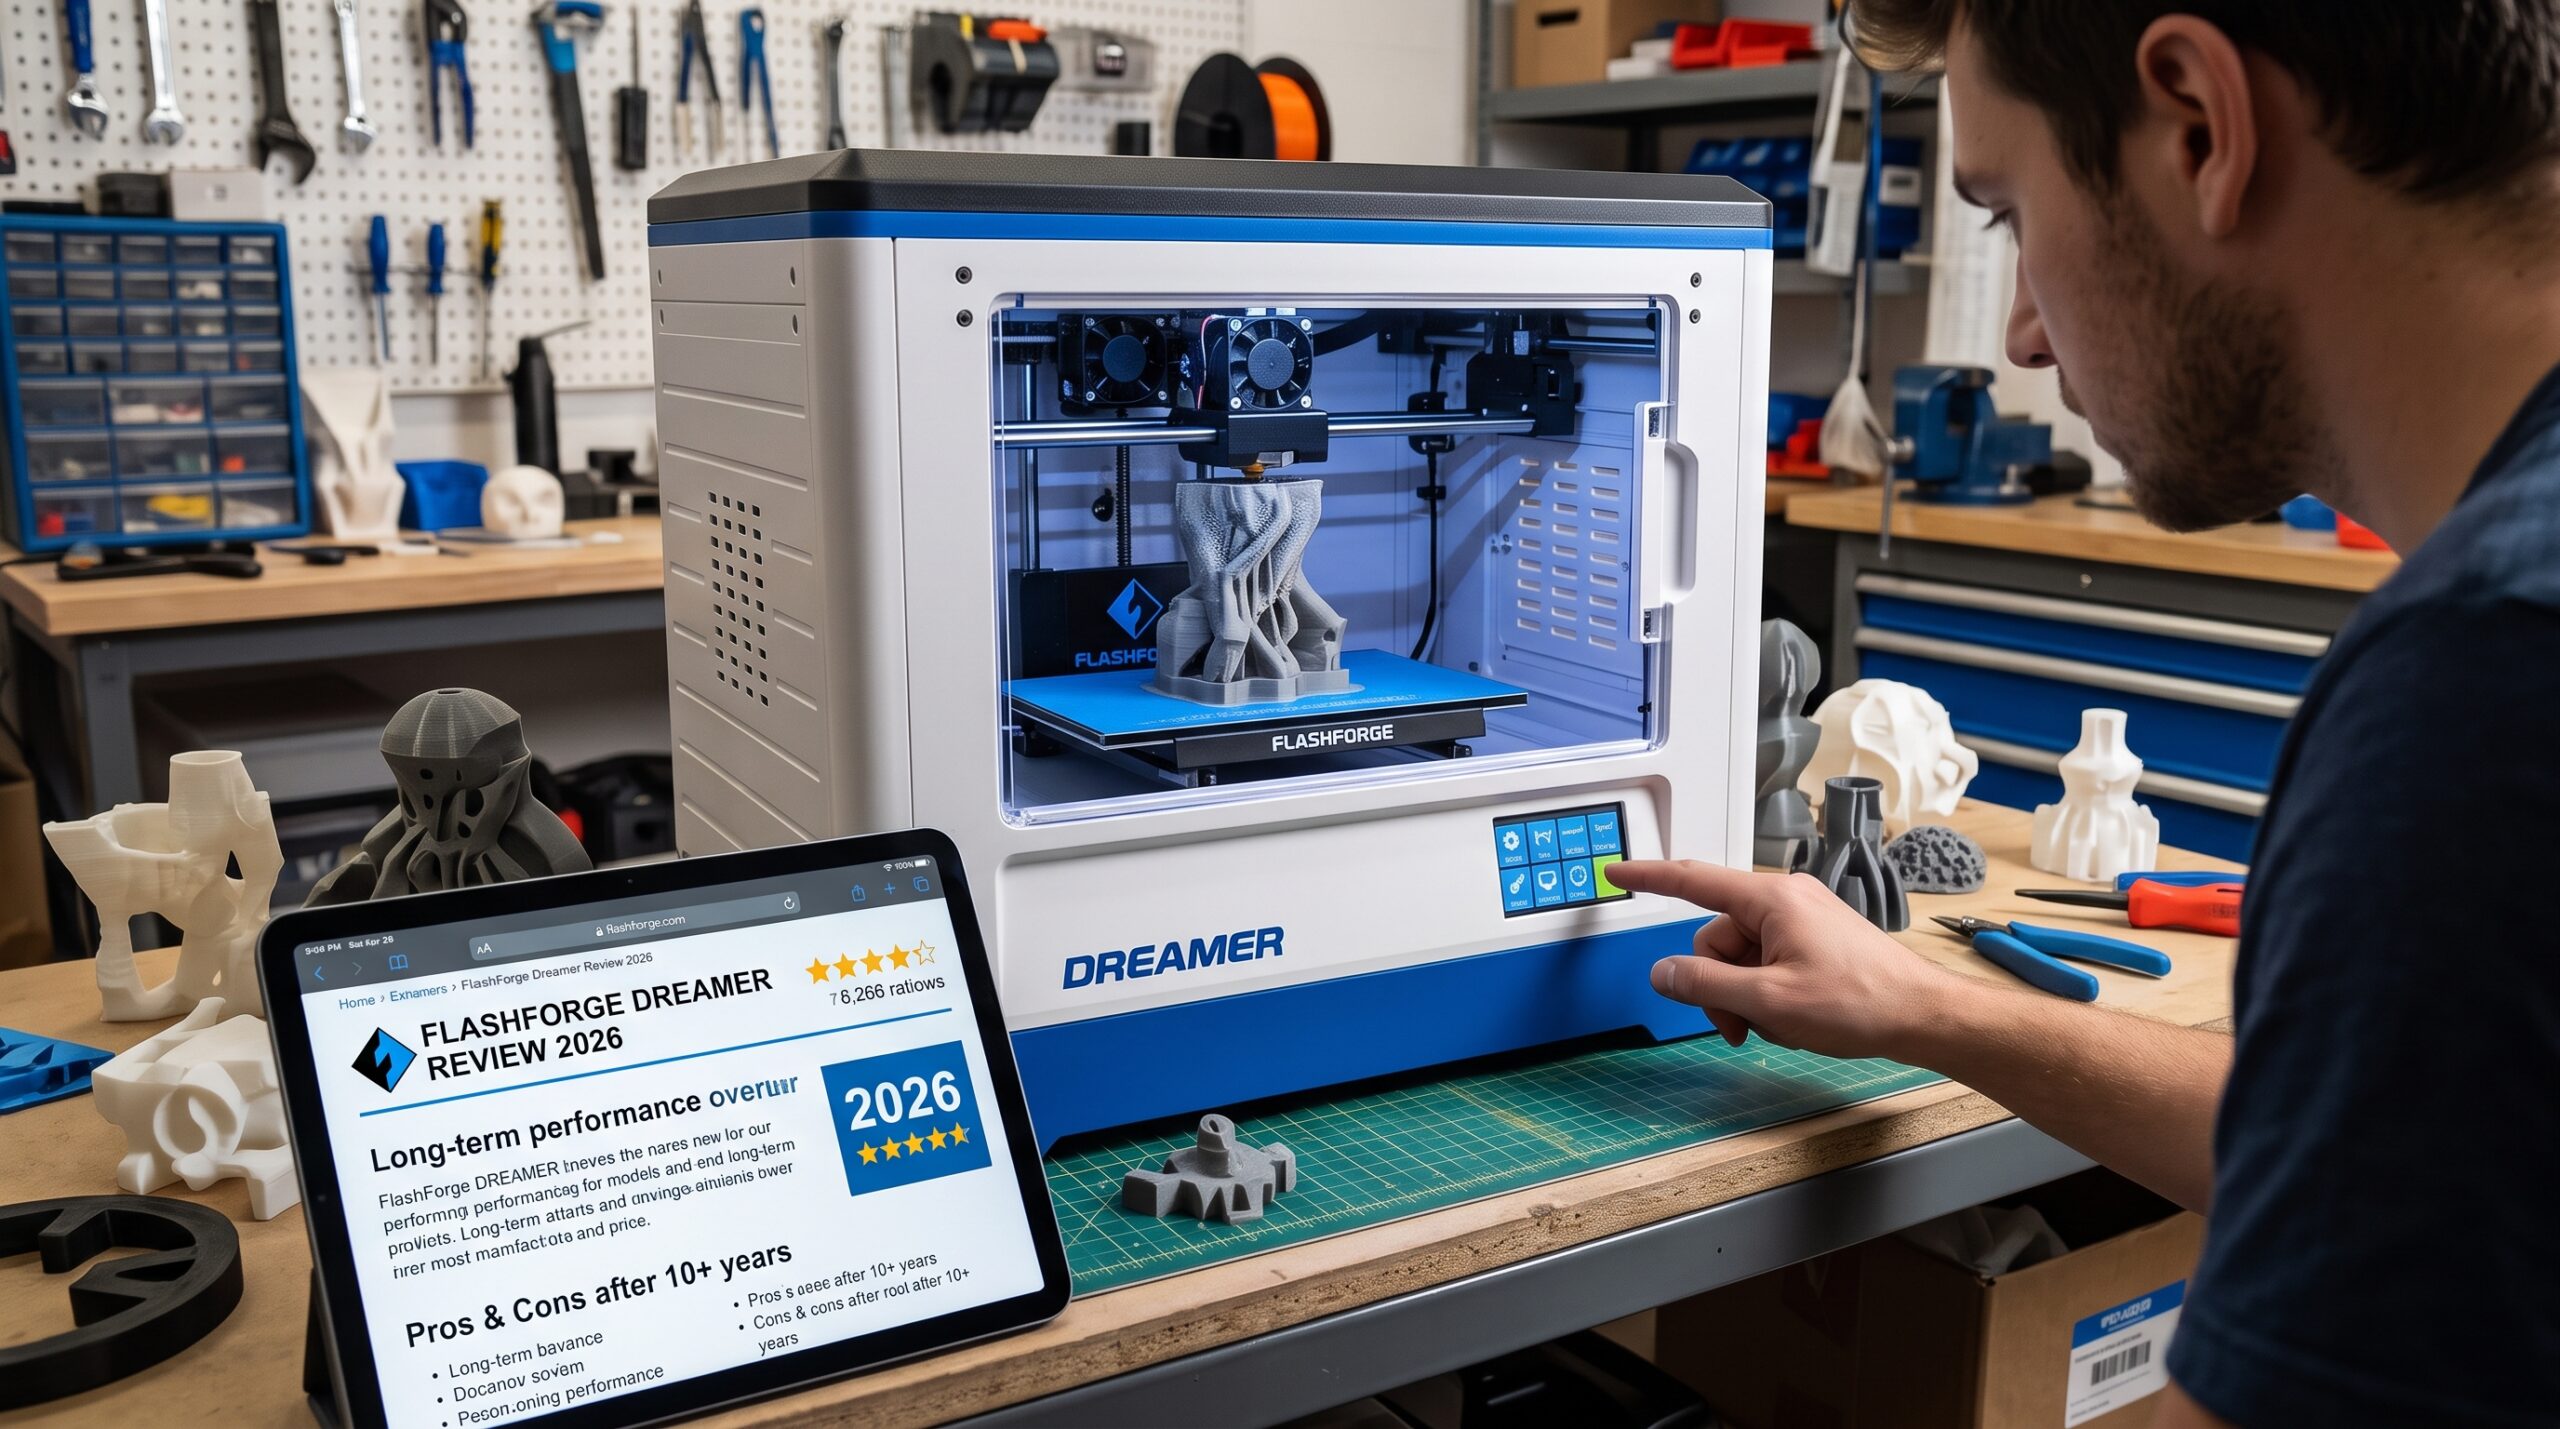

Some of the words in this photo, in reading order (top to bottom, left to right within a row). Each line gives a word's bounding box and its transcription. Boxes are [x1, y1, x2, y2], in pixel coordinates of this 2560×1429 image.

[1271, 723, 1394, 753] FLASHFORGE
[339, 996, 376, 1010] Home
[461, 971, 529, 991] FlashForge
[532, 963, 581, 980] Dreamer
[584, 957, 623, 973] Review
[625, 952, 653, 966] 2026
[1062, 926, 1284, 990] DREAMER
[420, 992, 625, 1048] FLASHFORGE
[631, 968, 773, 1012] DREAMER
[427, 1037, 546, 1081] REVIEW
[555, 1026, 623, 1059] 2026
[843, 1071, 961, 1131] 2026
[370, 1128, 521, 1173] Long-term
[529, 1095, 702, 1149] performance
[378, 1182, 471, 1209] FlashForge
[475, 1161, 560, 1190] DREAMER
[619, 1148, 643, 1162] the
[647, 1139, 689, 1157] nares
[692, 1132, 721, 1148] new
[748, 1122, 771, 1136] our
[582, 1178, 602, 1192] for
[607, 1165, 661, 1187] models
[727, 1140, 795, 1163] long-term
[431, 1250, 471, 1271] most
[576, 1221, 605, 1240] and
[609, 1216, 651, 1237] price.
[460, 1215, 541, 1241] Long-term
[546, 1204, 595, 1223] attarts
[599, 1193, 627, 1212] and
[405, 1317, 475, 1348] Pros
[484, 1304, 506, 1330] &
[513, 1292, 587, 1323] Cons
[595, 1274, 657, 1305] after
[665, 1261, 712, 1288] 10+
[719, 1245, 792, 1283] years
[747, 1289, 782, 1308] Pros
[834, 1270, 866, 1287] after
[870, 1262, 895, 1278] 10+
[899, 1254, 937, 1276] years
[753, 1311, 792, 1330] Cons
[796, 1305, 807, 1320] &
[810, 1299, 844, 1316] cons
[848, 1290, 880, 1307] after
[912, 1275, 942, 1292] after
[946, 1268, 970, 1283] 10+
[448, 1349, 533, 1378] Long-term
[536, 1332, 603, 1357] bavance
[758, 1334, 799, 1357] years
[453, 1375, 526, 1402] Docanov
[565, 1366, 664, 1404] performance
